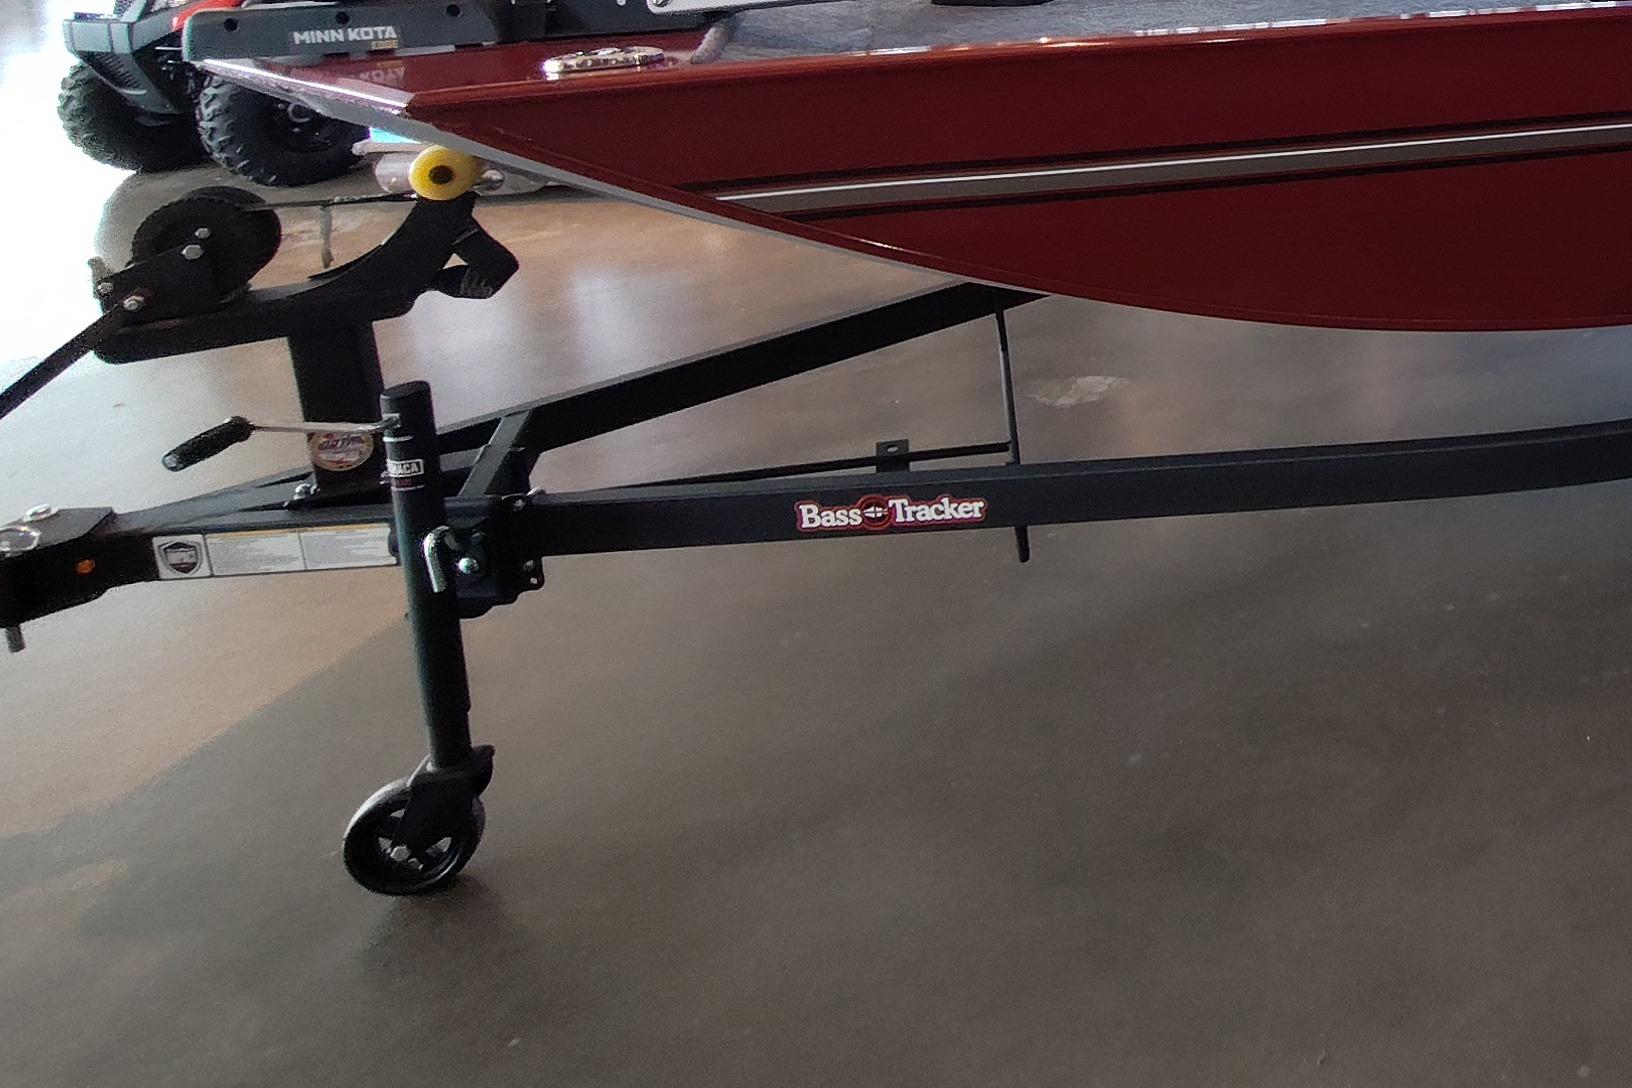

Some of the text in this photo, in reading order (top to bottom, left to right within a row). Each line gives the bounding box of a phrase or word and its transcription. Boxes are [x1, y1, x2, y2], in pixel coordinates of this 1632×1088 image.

[293, 25, 398, 45] MINN KOTA
[799, 497, 985, 529] Bass Tracker
